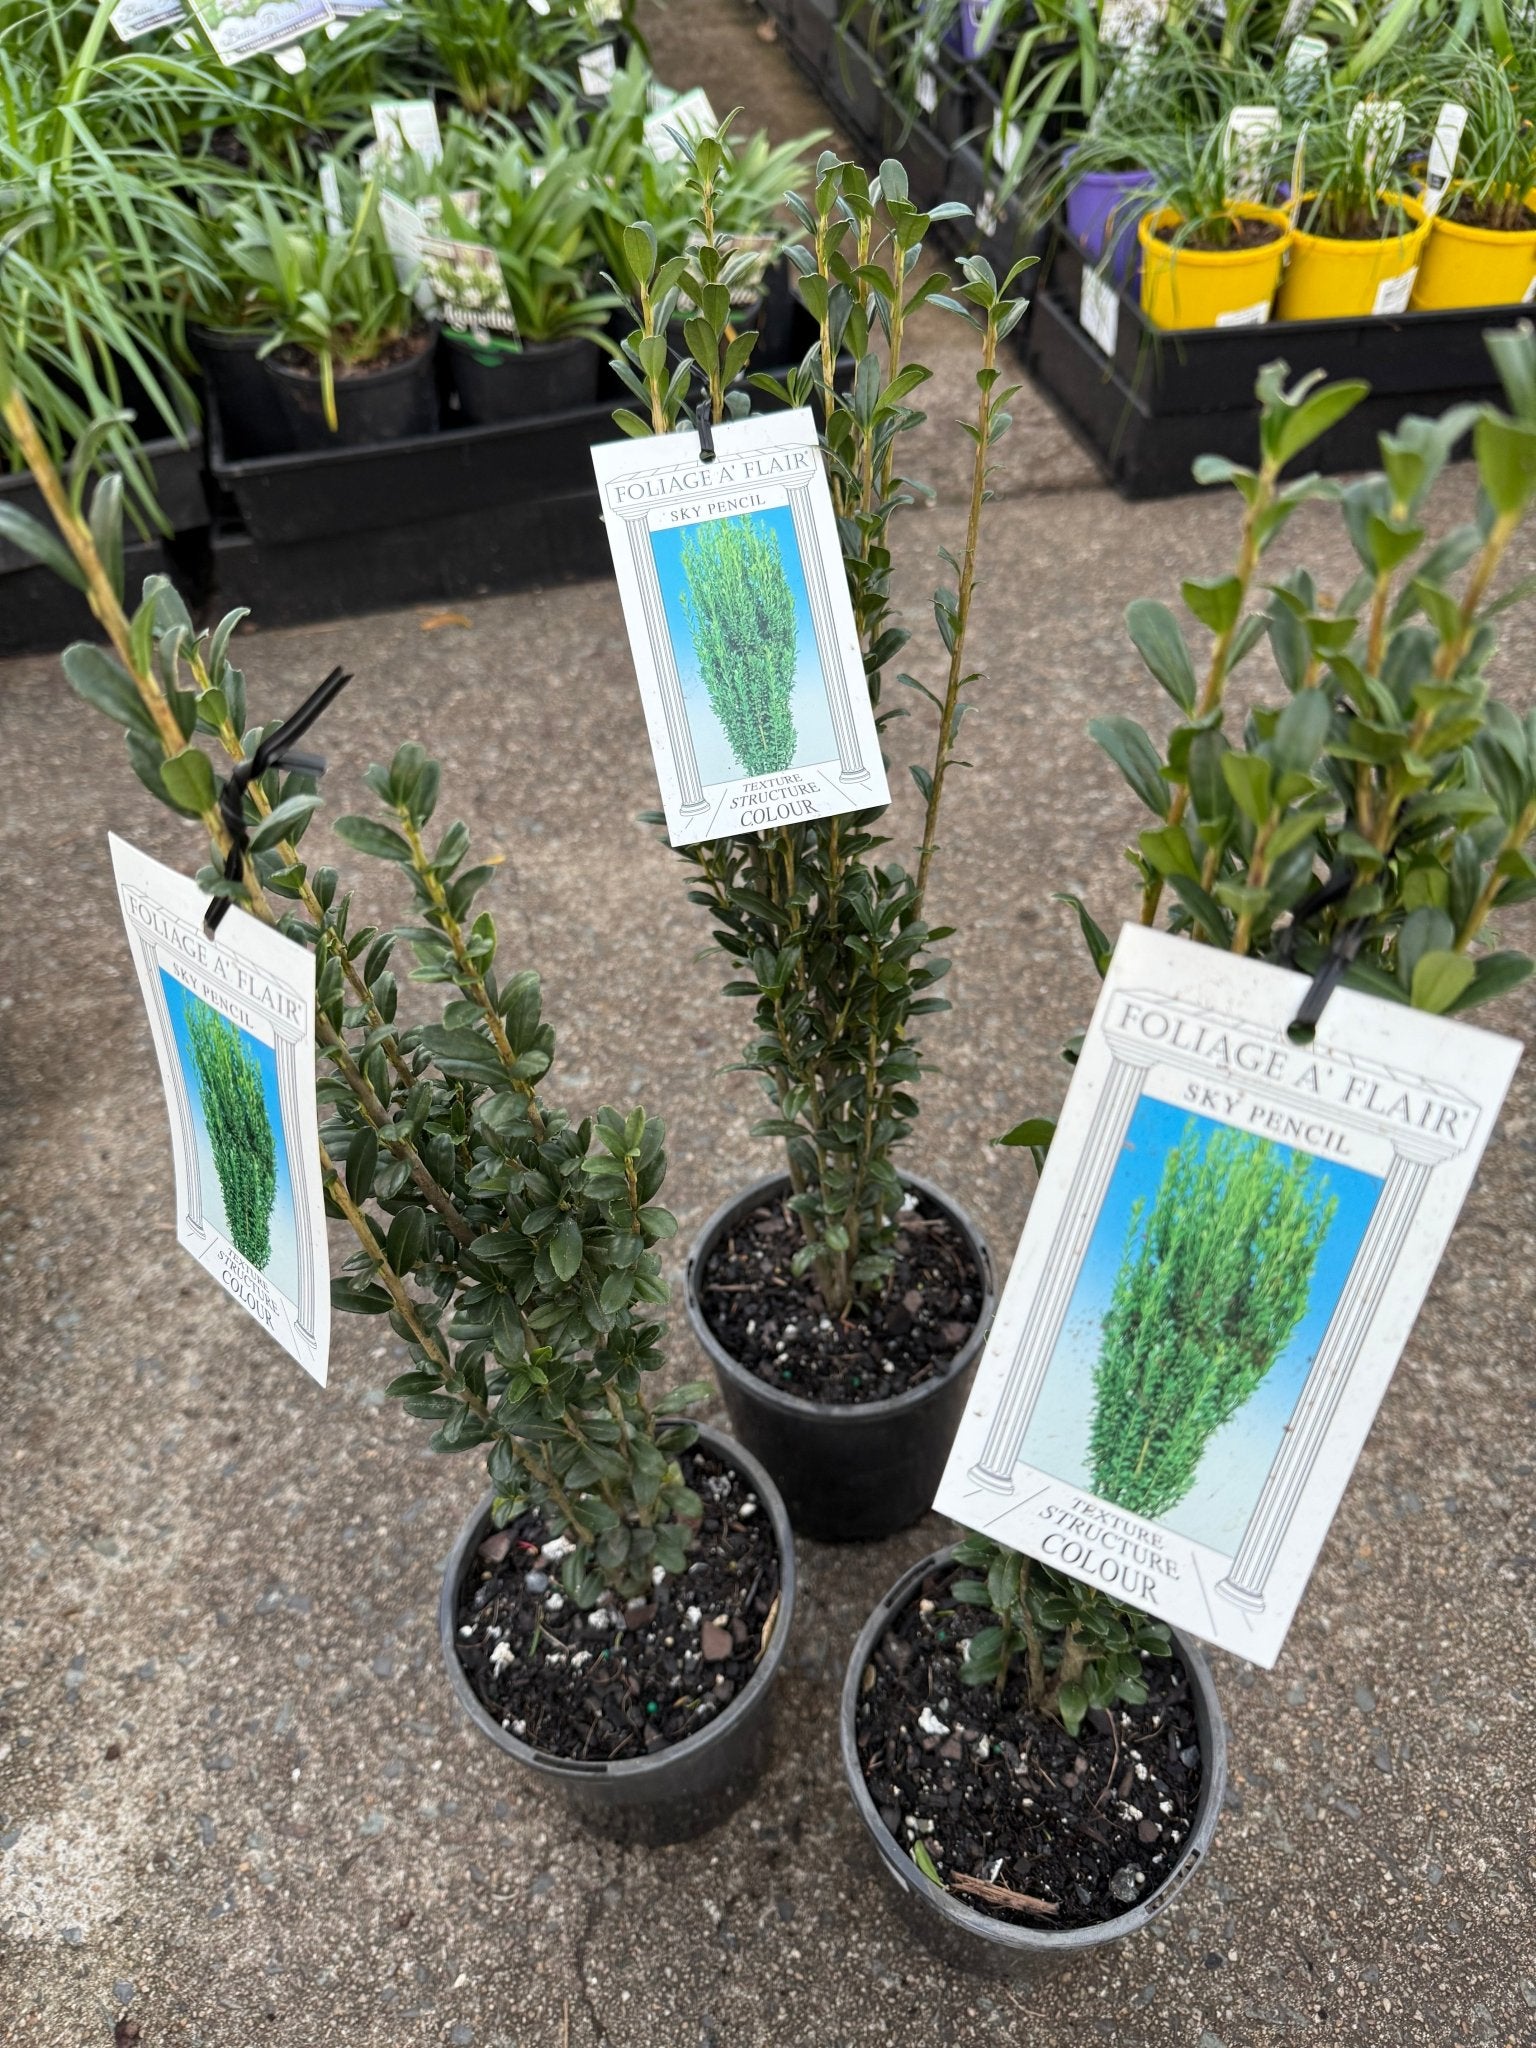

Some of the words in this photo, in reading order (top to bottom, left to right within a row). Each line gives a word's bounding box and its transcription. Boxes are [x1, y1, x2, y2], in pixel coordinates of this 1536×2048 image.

[614, 469, 713, 503] FOLIAGE
[744, 451, 809, 479] FLAIR
[671, 506, 703, 523] SKY
[708, 494, 766, 515] PENCIL
[730, 782, 821, 809] STRUCTURE
[740, 799, 819, 827] COLOUR
[742, 773, 803, 793] TEXTURE
[129, 895, 208, 967] FOLIAGE
[238, 969, 301, 1025] FLAIR
[173, 962, 199, 988] SKY
[202, 983, 254, 1029] PENCIL
[1118, 1004, 1289, 1081] FOLIAGE
[1341, 1075, 1469, 1139] FLAIR
[1183, 1082, 1239, 1117] SKY
[1249, 1105, 1352, 1155] PENCIL
[218, 1250, 280, 1316] STRUCTURE
[222, 1270, 275, 1331] COLOUR
[227, 1248, 270, 1293] TEXTURE
[1038, 1505, 1180, 1581] STRUCTURE
[1072, 1497, 1164, 1551] TEXTURE
[1041, 1533, 1159, 1604] COLOUR
